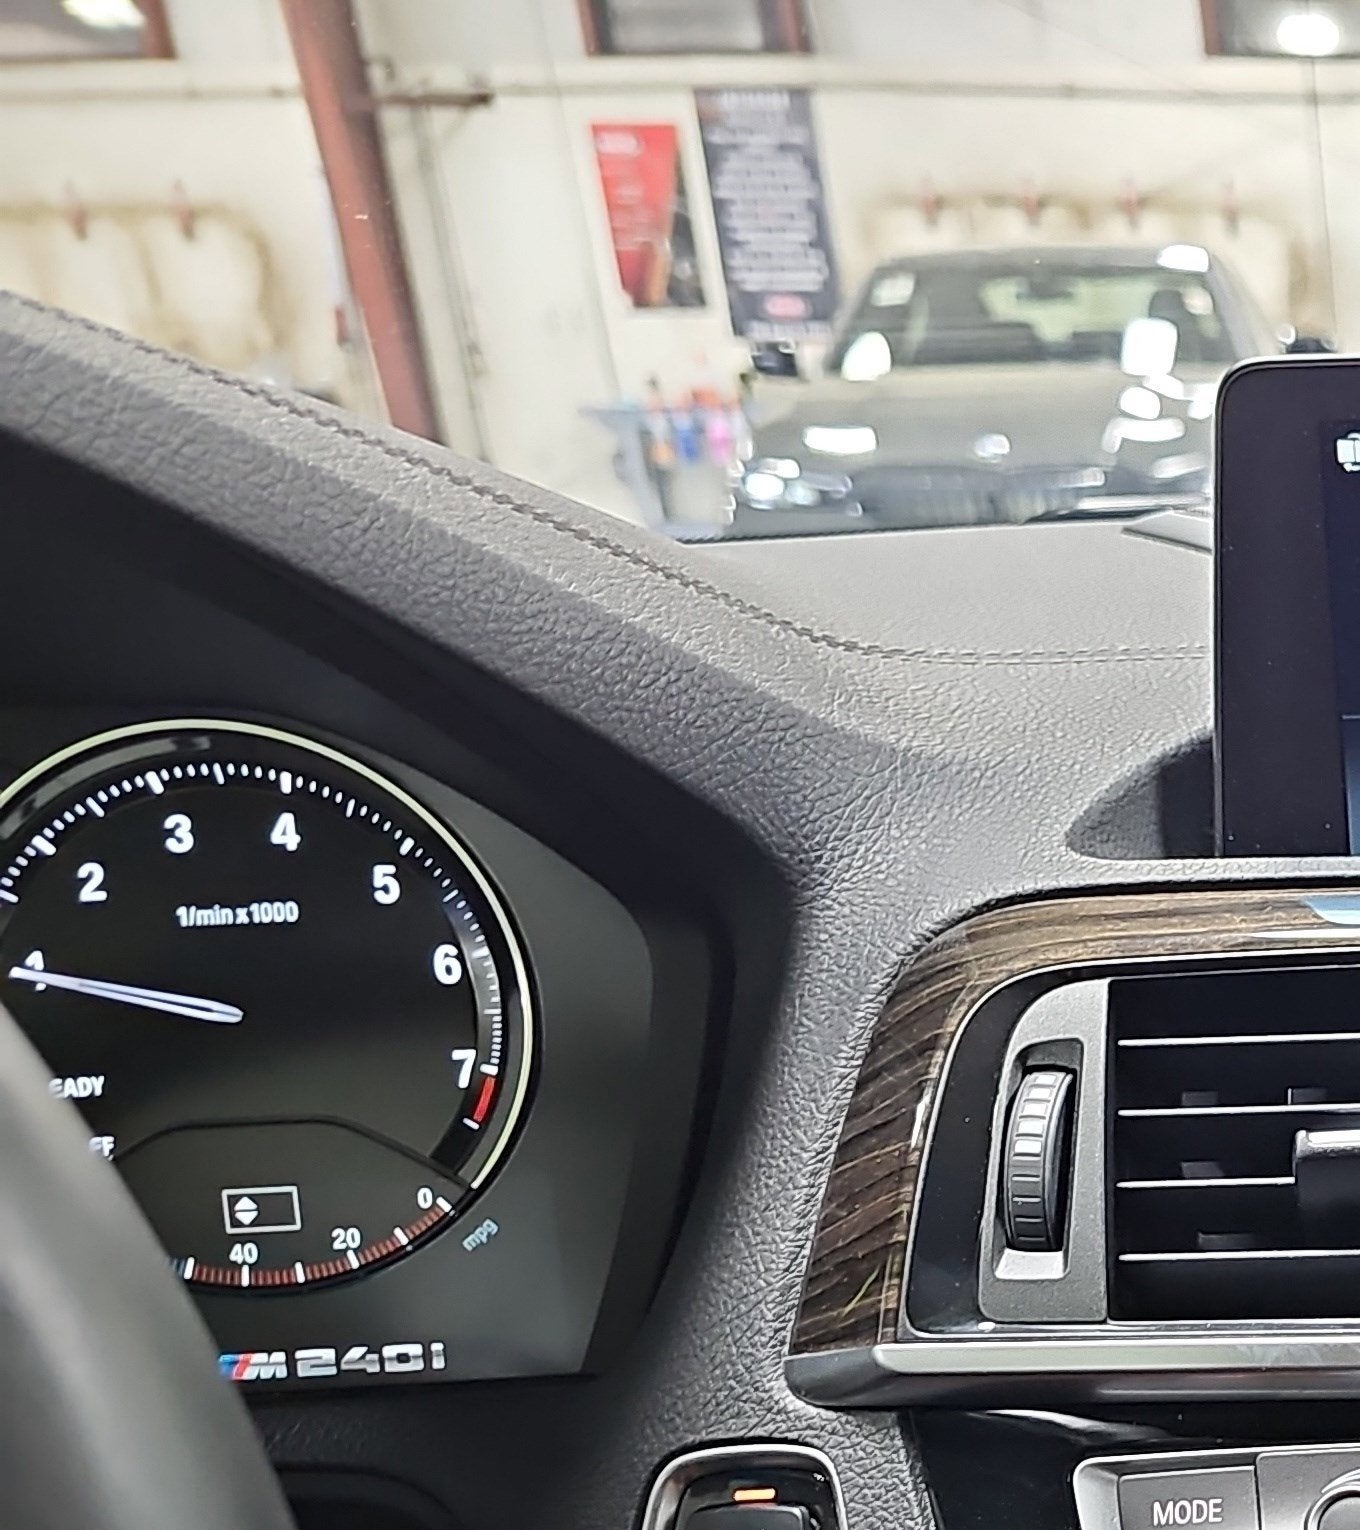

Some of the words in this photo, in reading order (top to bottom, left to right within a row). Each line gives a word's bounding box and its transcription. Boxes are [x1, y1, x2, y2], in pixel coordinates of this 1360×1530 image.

[163, 813, 195, 854] 3
[270, 812, 301, 852] 4
[77, 862, 108, 903] 2
[372, 864, 401, 905] 5
[433, 944, 462, 985] 6
[48, 1075, 105, 1098] EADY
[451, 1048, 477, 1089] 7
[417, 1187, 433, 1209] 0
[331, 1227, 361, 1249] 20
[462, 1218, 499, 1251] mpg
[229, 1242, 259, 1264] 40
[1153, 1498, 1223, 1526] MODE
